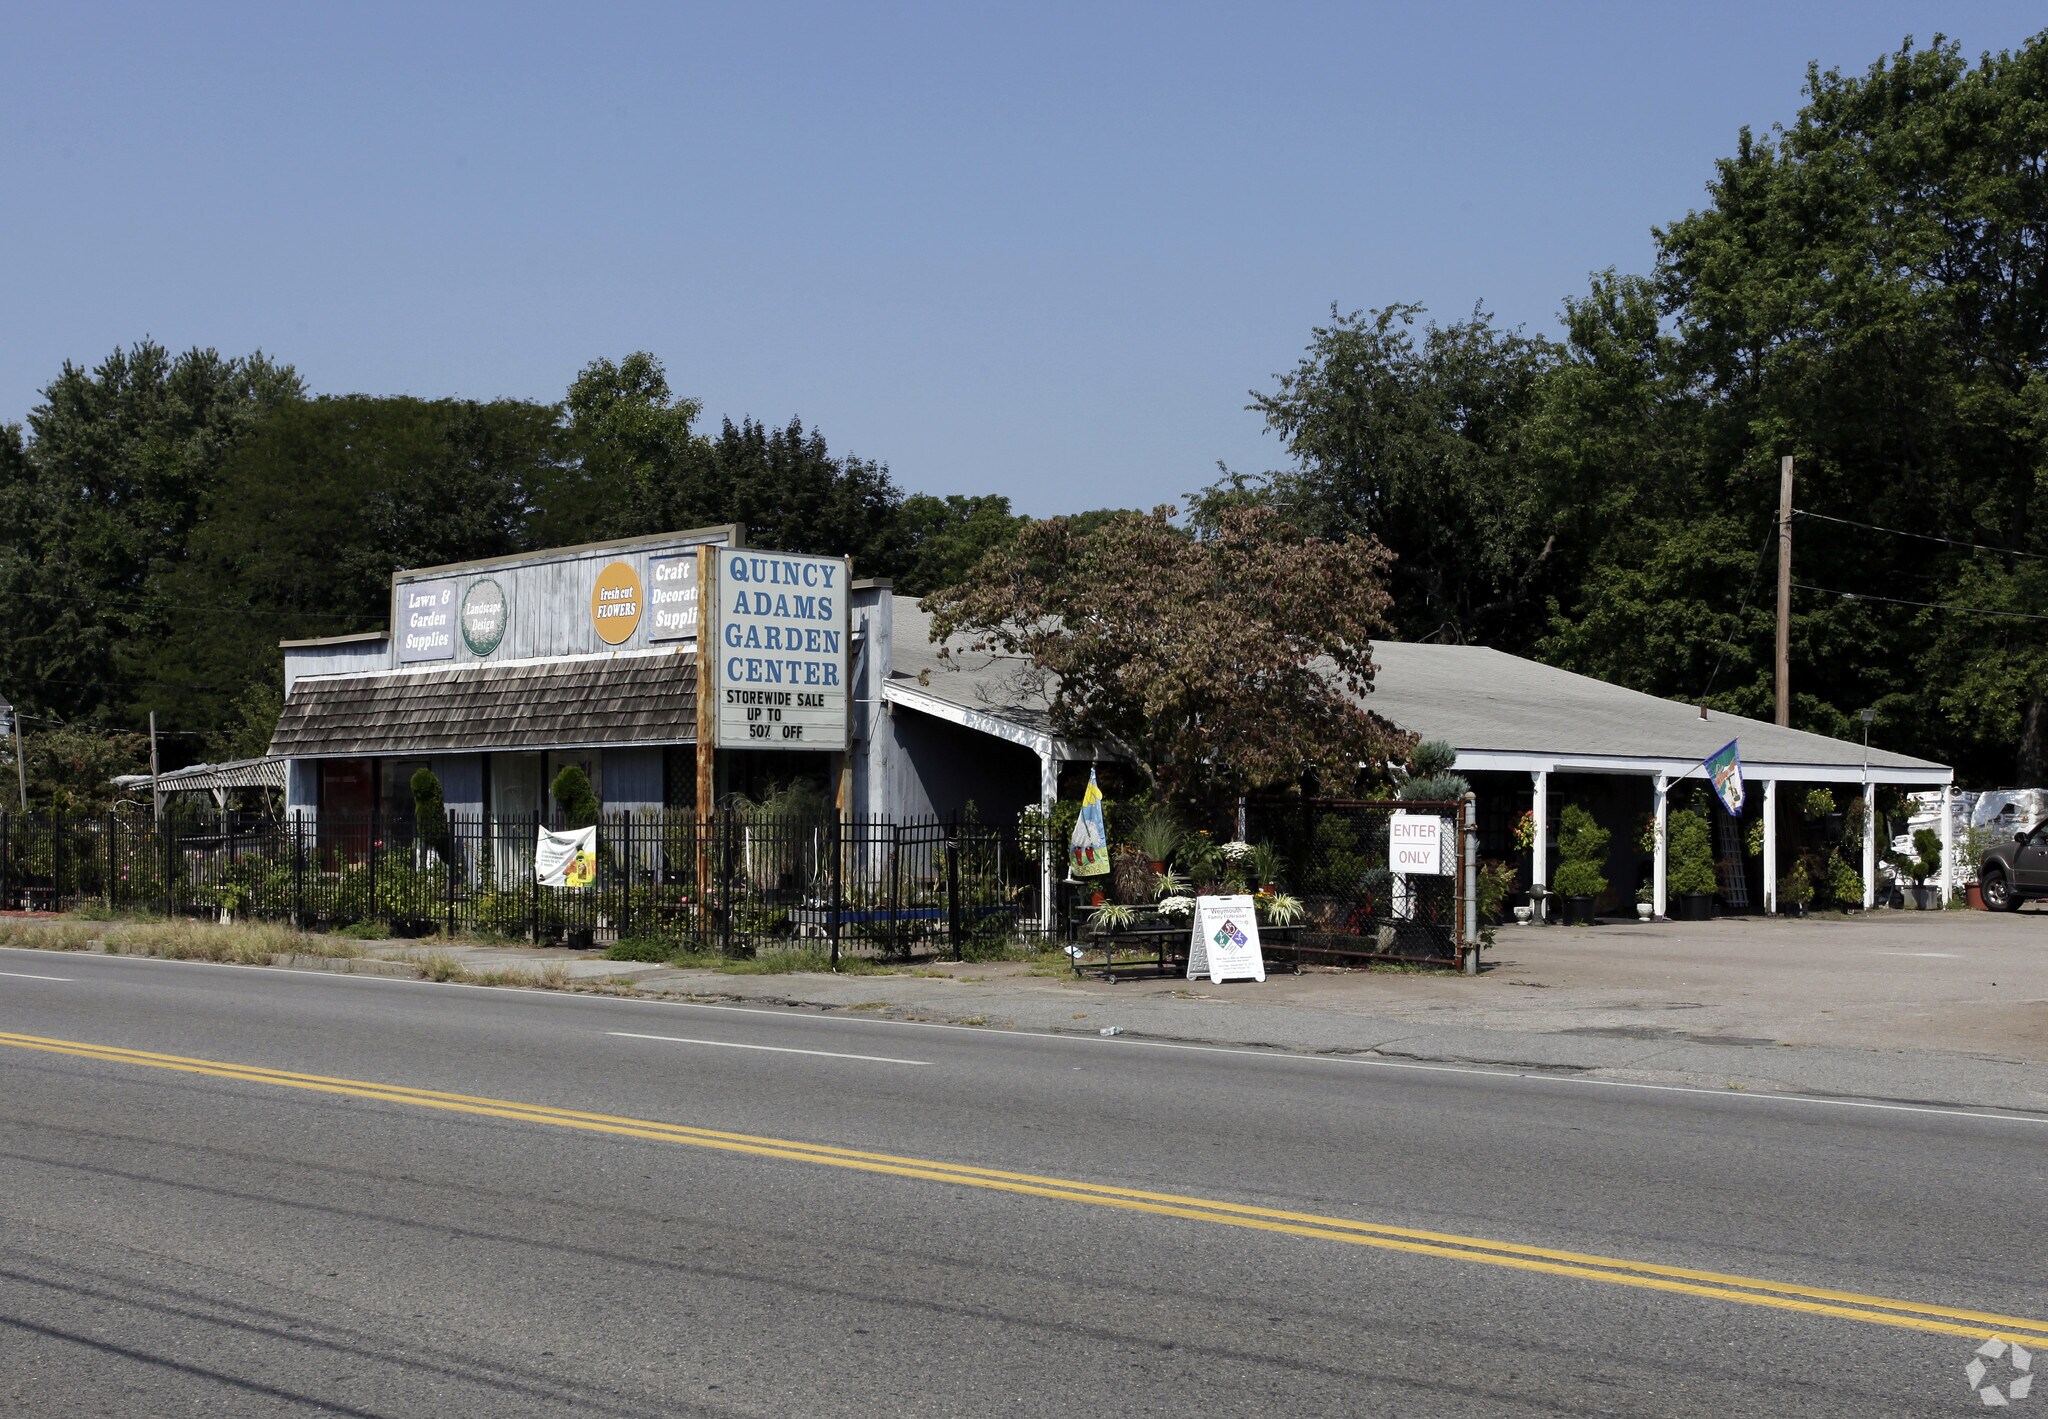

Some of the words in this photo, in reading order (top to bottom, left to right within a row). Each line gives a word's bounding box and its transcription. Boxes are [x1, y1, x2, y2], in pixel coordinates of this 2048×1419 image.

[655, 562, 690, 582] Craft
[730, 556, 836, 589] QUINCY
[409, 593, 436, 608] Lawn
[441, 589, 450, 604] &
[600, 586, 620, 601] fresh
[620, 586, 634, 599] cut
[466, 602, 501, 616] Landscape
[596, 602, 636, 619] FLOWERS
[732, 590, 833, 621] ADAMS
[411, 612, 446, 628] Garden
[472, 618, 495, 633] Design
[405, 631, 448, 650] Supplies
[725, 622, 841, 654] GARDEN
[727, 656, 840, 686] CENTER
[726, 689, 792, 707] STOREWIDE
[797, 693, 825, 707] SALE
[747, 707, 762, 721] UP
[767, 707, 782, 722] TO
[749, 724, 771, 739] 50%
[782, 725, 803, 739] OFF
[1394, 824, 1436, 838] ENTER
[1399, 850, 1431, 864] ONLY
